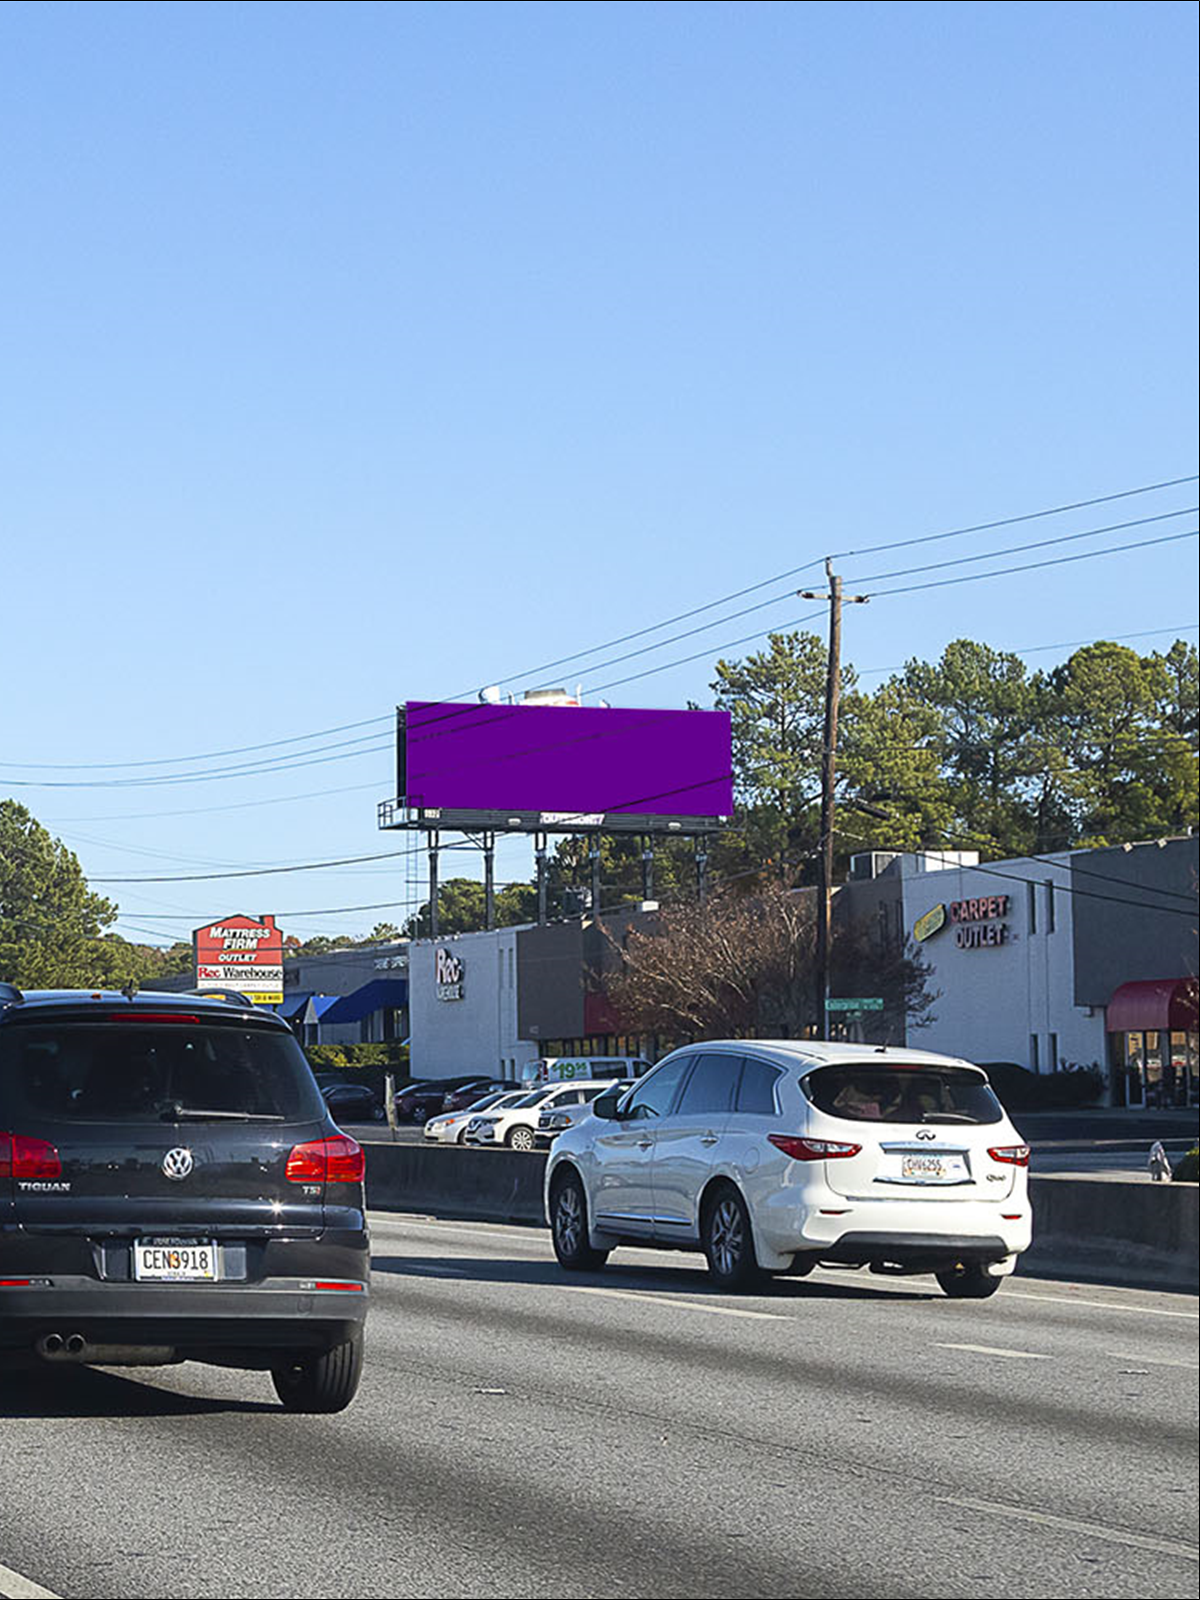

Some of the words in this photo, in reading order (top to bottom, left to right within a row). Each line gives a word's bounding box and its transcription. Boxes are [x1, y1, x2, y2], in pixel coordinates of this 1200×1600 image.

[951, 896, 1006, 922] CARPET
[209, 927, 271, 939] MATTRESS
[957, 923, 1003, 948] OUTLET
[223, 939, 258, 950] FIRM
[218, 953, 257, 962] OUTLET
[198, 966, 220, 978] Rec
[223, 966, 282, 979] Warehouse
[18, 1182, 71, 1191] TIGUAN
[143, 1250, 209, 1270] CEN3918
